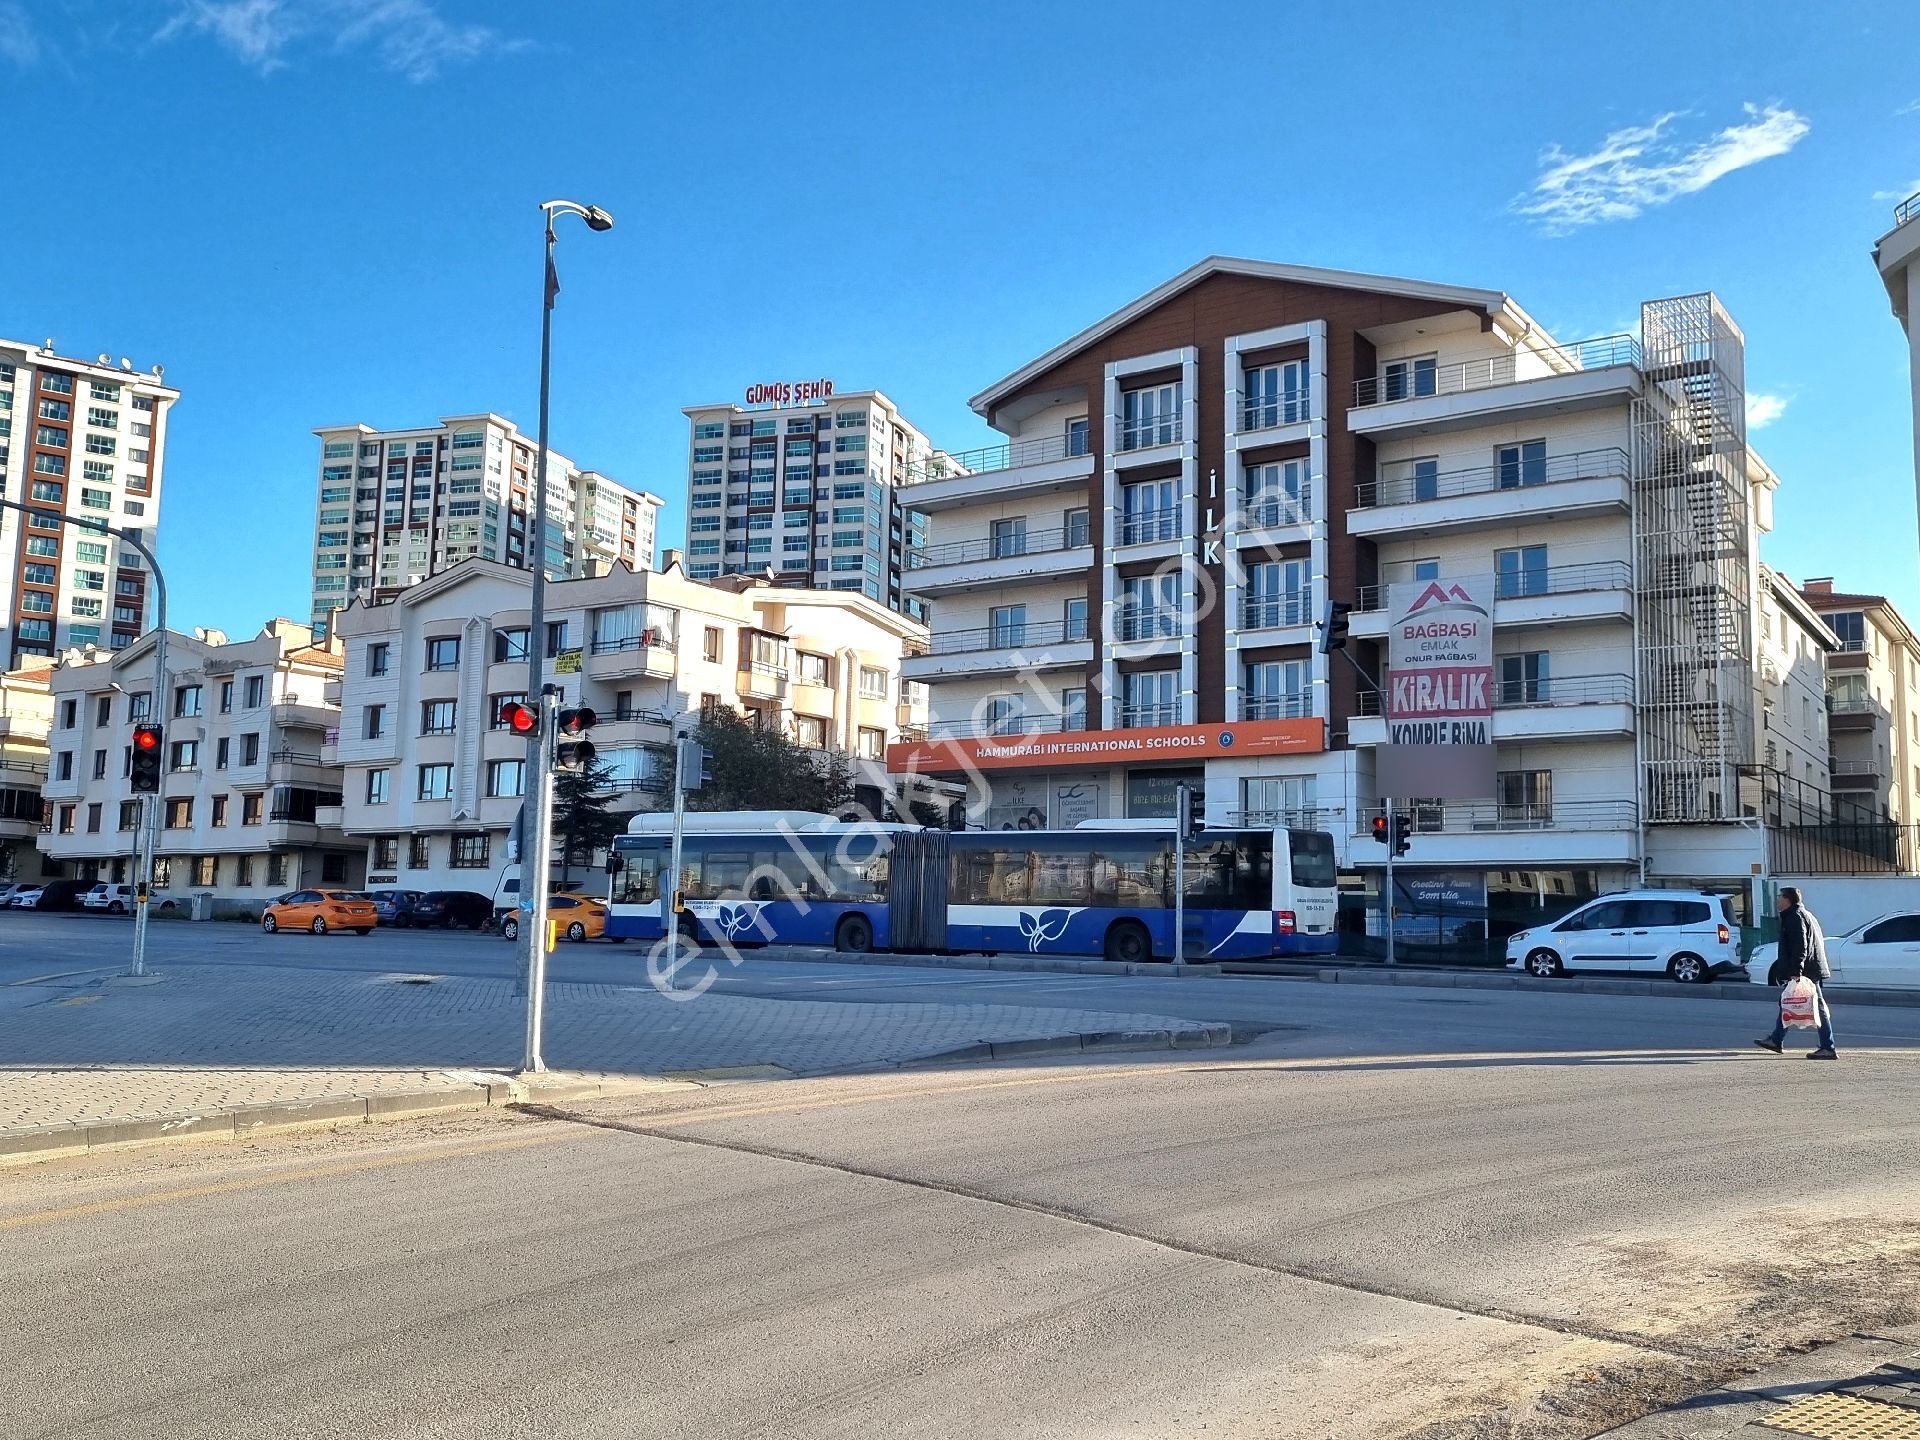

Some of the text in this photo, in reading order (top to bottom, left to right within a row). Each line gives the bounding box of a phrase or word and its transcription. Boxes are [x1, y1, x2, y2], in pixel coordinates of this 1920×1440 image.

[746, 377, 833, 404] GÜMÜŞ ŞEHİR
[1403, 622, 1477, 640] BAĞBAŞI
[1420, 640, 1458, 651] EMLAK
[1404, 654, 1433, 663] ONUR
[1047, 740, 1143, 754] INTERNATIONAL
[1146, 735, 1206, 749] SCHOOLS
